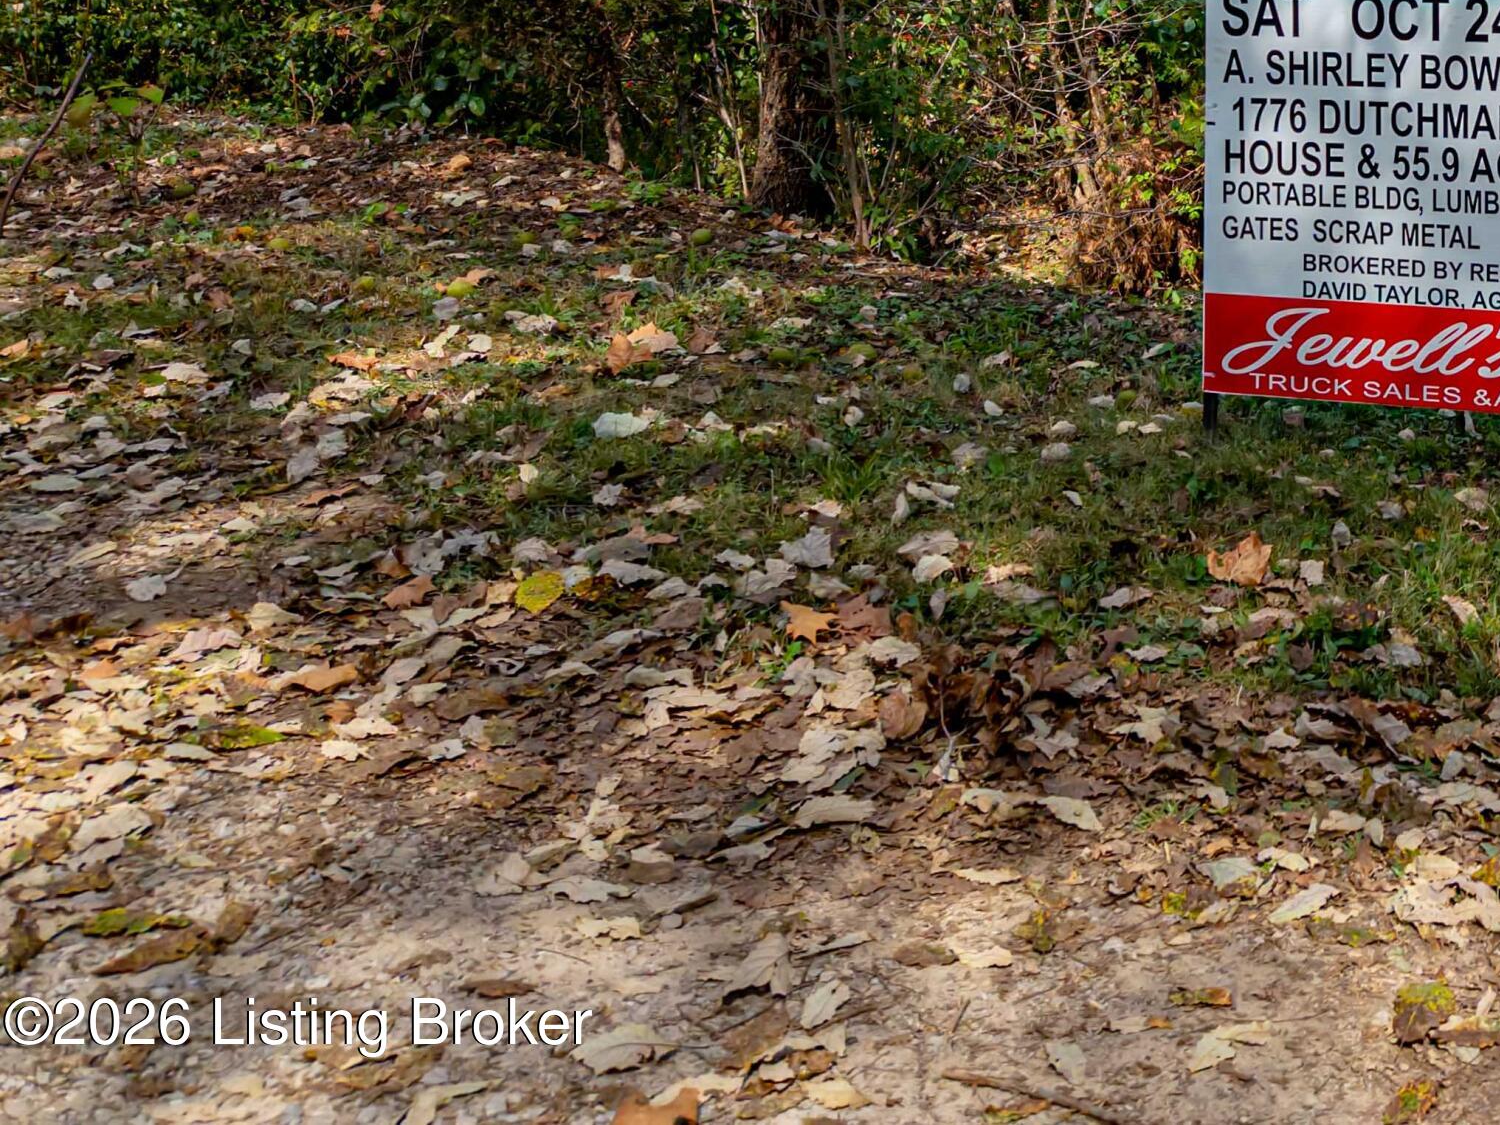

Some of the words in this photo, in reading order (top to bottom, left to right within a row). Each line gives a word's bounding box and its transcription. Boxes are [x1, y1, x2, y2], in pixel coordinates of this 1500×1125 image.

[1223, 51, 1255, 84] A.
[1266, 52, 1409, 89] SHIRLEY
[1233, 98, 1305, 134] 1776
[1225, 141, 1344, 177] HOUSE
[1358, 145, 1381, 178] &
[1393, 147, 1459, 182] 55.9
[1223, 182, 1346, 208] PORTABLE
[1354, 186, 1424, 214] BLDG,
[1223, 217, 1298, 242] GATES
[1313, 220, 1393, 246] SCRAP
[1401, 224, 1480, 249] METAL
[1303, 255, 1425, 279] BROKERED
[1433, 261, 1463, 281] BY
[1303, 281, 1367, 301] DAVID
[1375, 286, 1465, 309] TAYLOR,
[1250, 373, 1352, 396] TRUCK
[1363, 381, 1463, 403] SALES
